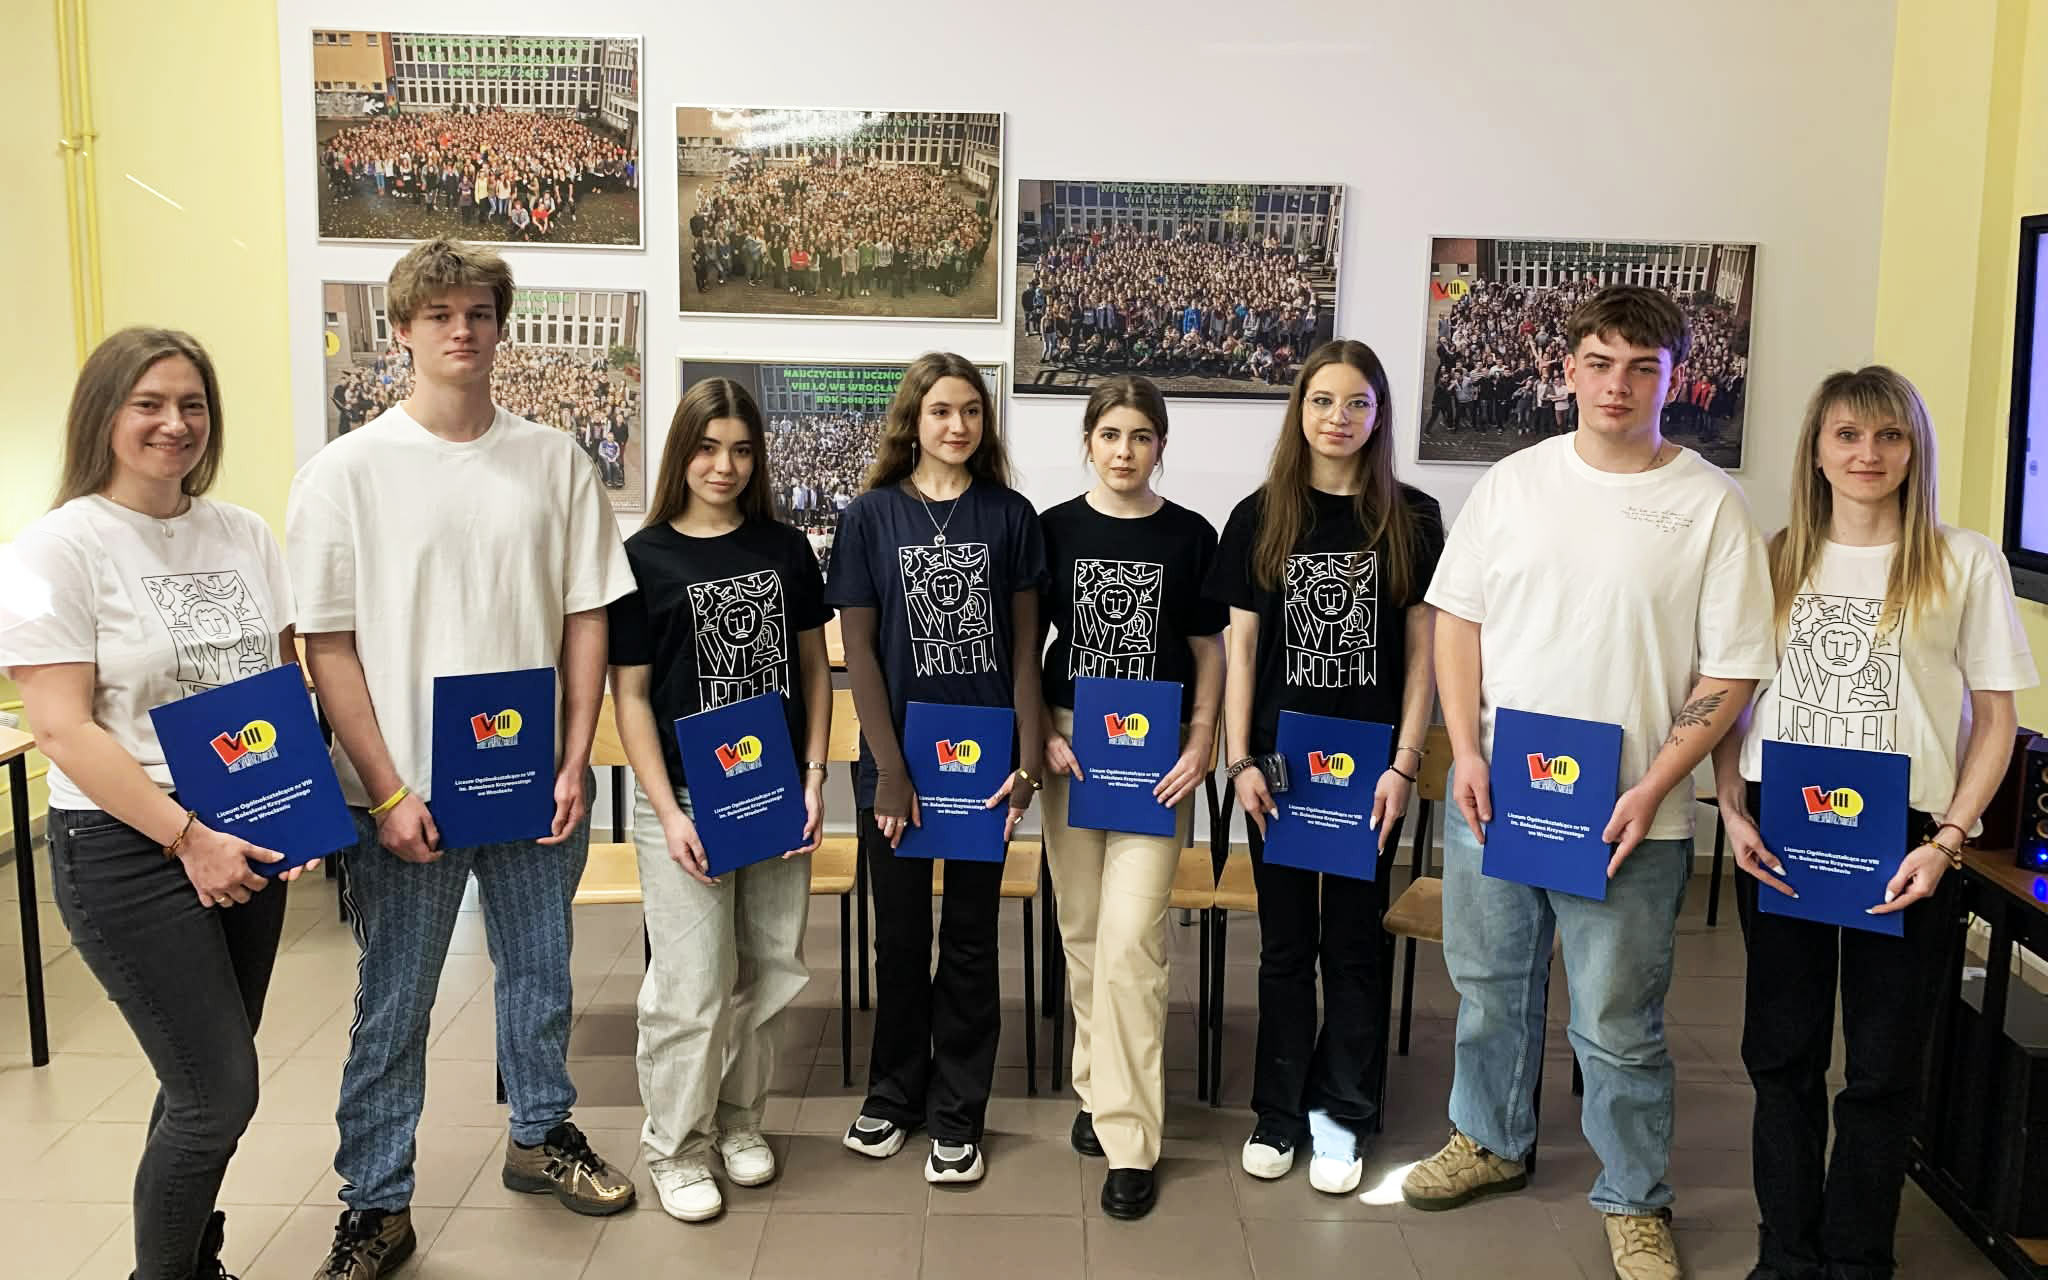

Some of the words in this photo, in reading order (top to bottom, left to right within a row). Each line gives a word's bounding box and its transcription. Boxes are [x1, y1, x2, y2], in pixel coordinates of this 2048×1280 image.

[783, 369, 855, 379] NAUCZYCIELE
[863, 371, 906, 381] UCZNIO
[792, 382, 810, 391] VIII
[812, 383, 827, 392] LO
[829, 384, 846, 392] WE
[815, 395, 839, 405] ROK
[912, 636, 998, 678] WROCŁAW
[1286, 648, 1377, 688] WROCŁAW
[481, 714, 510, 731] VIII
[1113, 715, 1138, 730] VIII
[222, 727, 262, 750] VIII
[724, 741, 752, 759] VIII
[944, 743, 970, 757] VIII
[1317, 754, 1343, 770] VIII
[1537, 756, 1567, 775] VIII
[216, 806, 240, 819] Liceum
[300, 778, 313, 787] VIII
[1815, 789, 1848, 808] VIII
